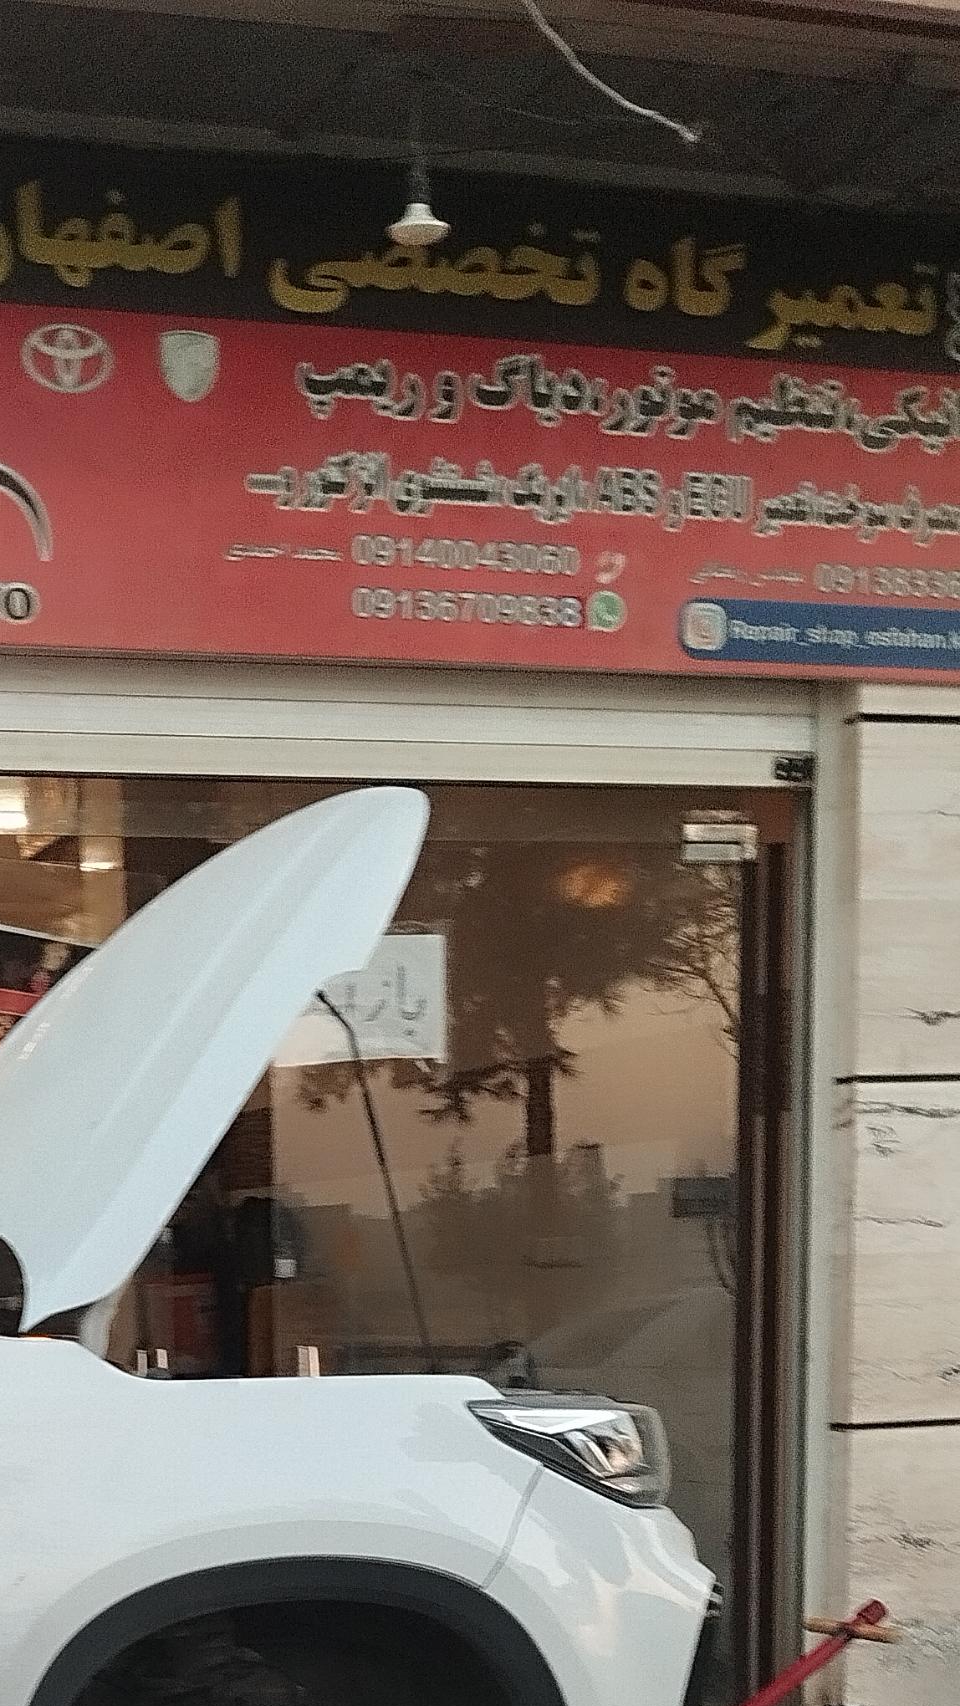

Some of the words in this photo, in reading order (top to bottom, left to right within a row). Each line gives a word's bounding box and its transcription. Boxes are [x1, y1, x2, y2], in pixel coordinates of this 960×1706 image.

[266, 222, 602, 314] تخصصی
[624, 235, 746, 318] گاه
[746, 262, 938, 350] تعمیر
